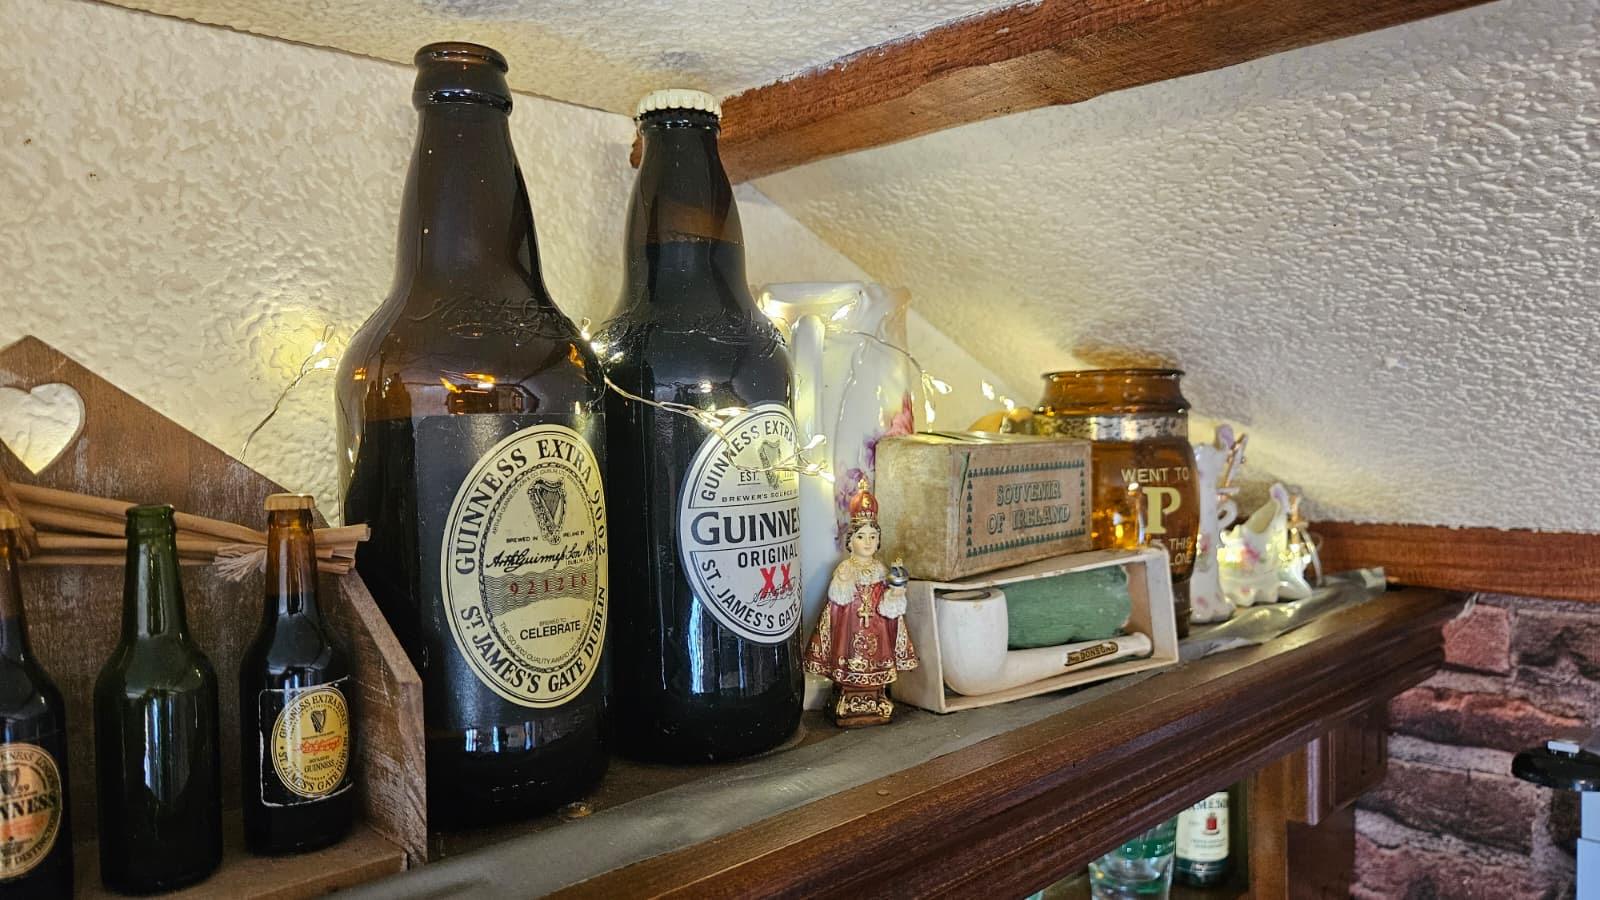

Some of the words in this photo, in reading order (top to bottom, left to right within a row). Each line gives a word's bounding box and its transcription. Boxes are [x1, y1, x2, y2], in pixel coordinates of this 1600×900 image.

[701, 424, 760, 502] GUINNESS
[764, 419, 794, 443] EXTRA
[1120, 467, 1169, 483] WENT
[1174, 466, 1190, 481] TO
[455, 447, 528, 576] GUINNESS
[535, 438, 592, 484] EXTRA
[996, 479, 1062, 507] SOUVENIR
[986, 512, 1006, 535] OF
[1012, 503, 1071, 530] IRELAND
[1141, 486, 1181, 535] P
[737, 542, 799, 569] ORIGINAL
[1167, 536, 1192, 551] THIS
[716, 588, 775, 630] JAMES'S
[472, 627, 542, 694] JAMES'S
[547, 658, 586, 694] GATE
[584, 586, 606, 661] DUBLIN
[519, 619, 581, 641] CELEBRATE
